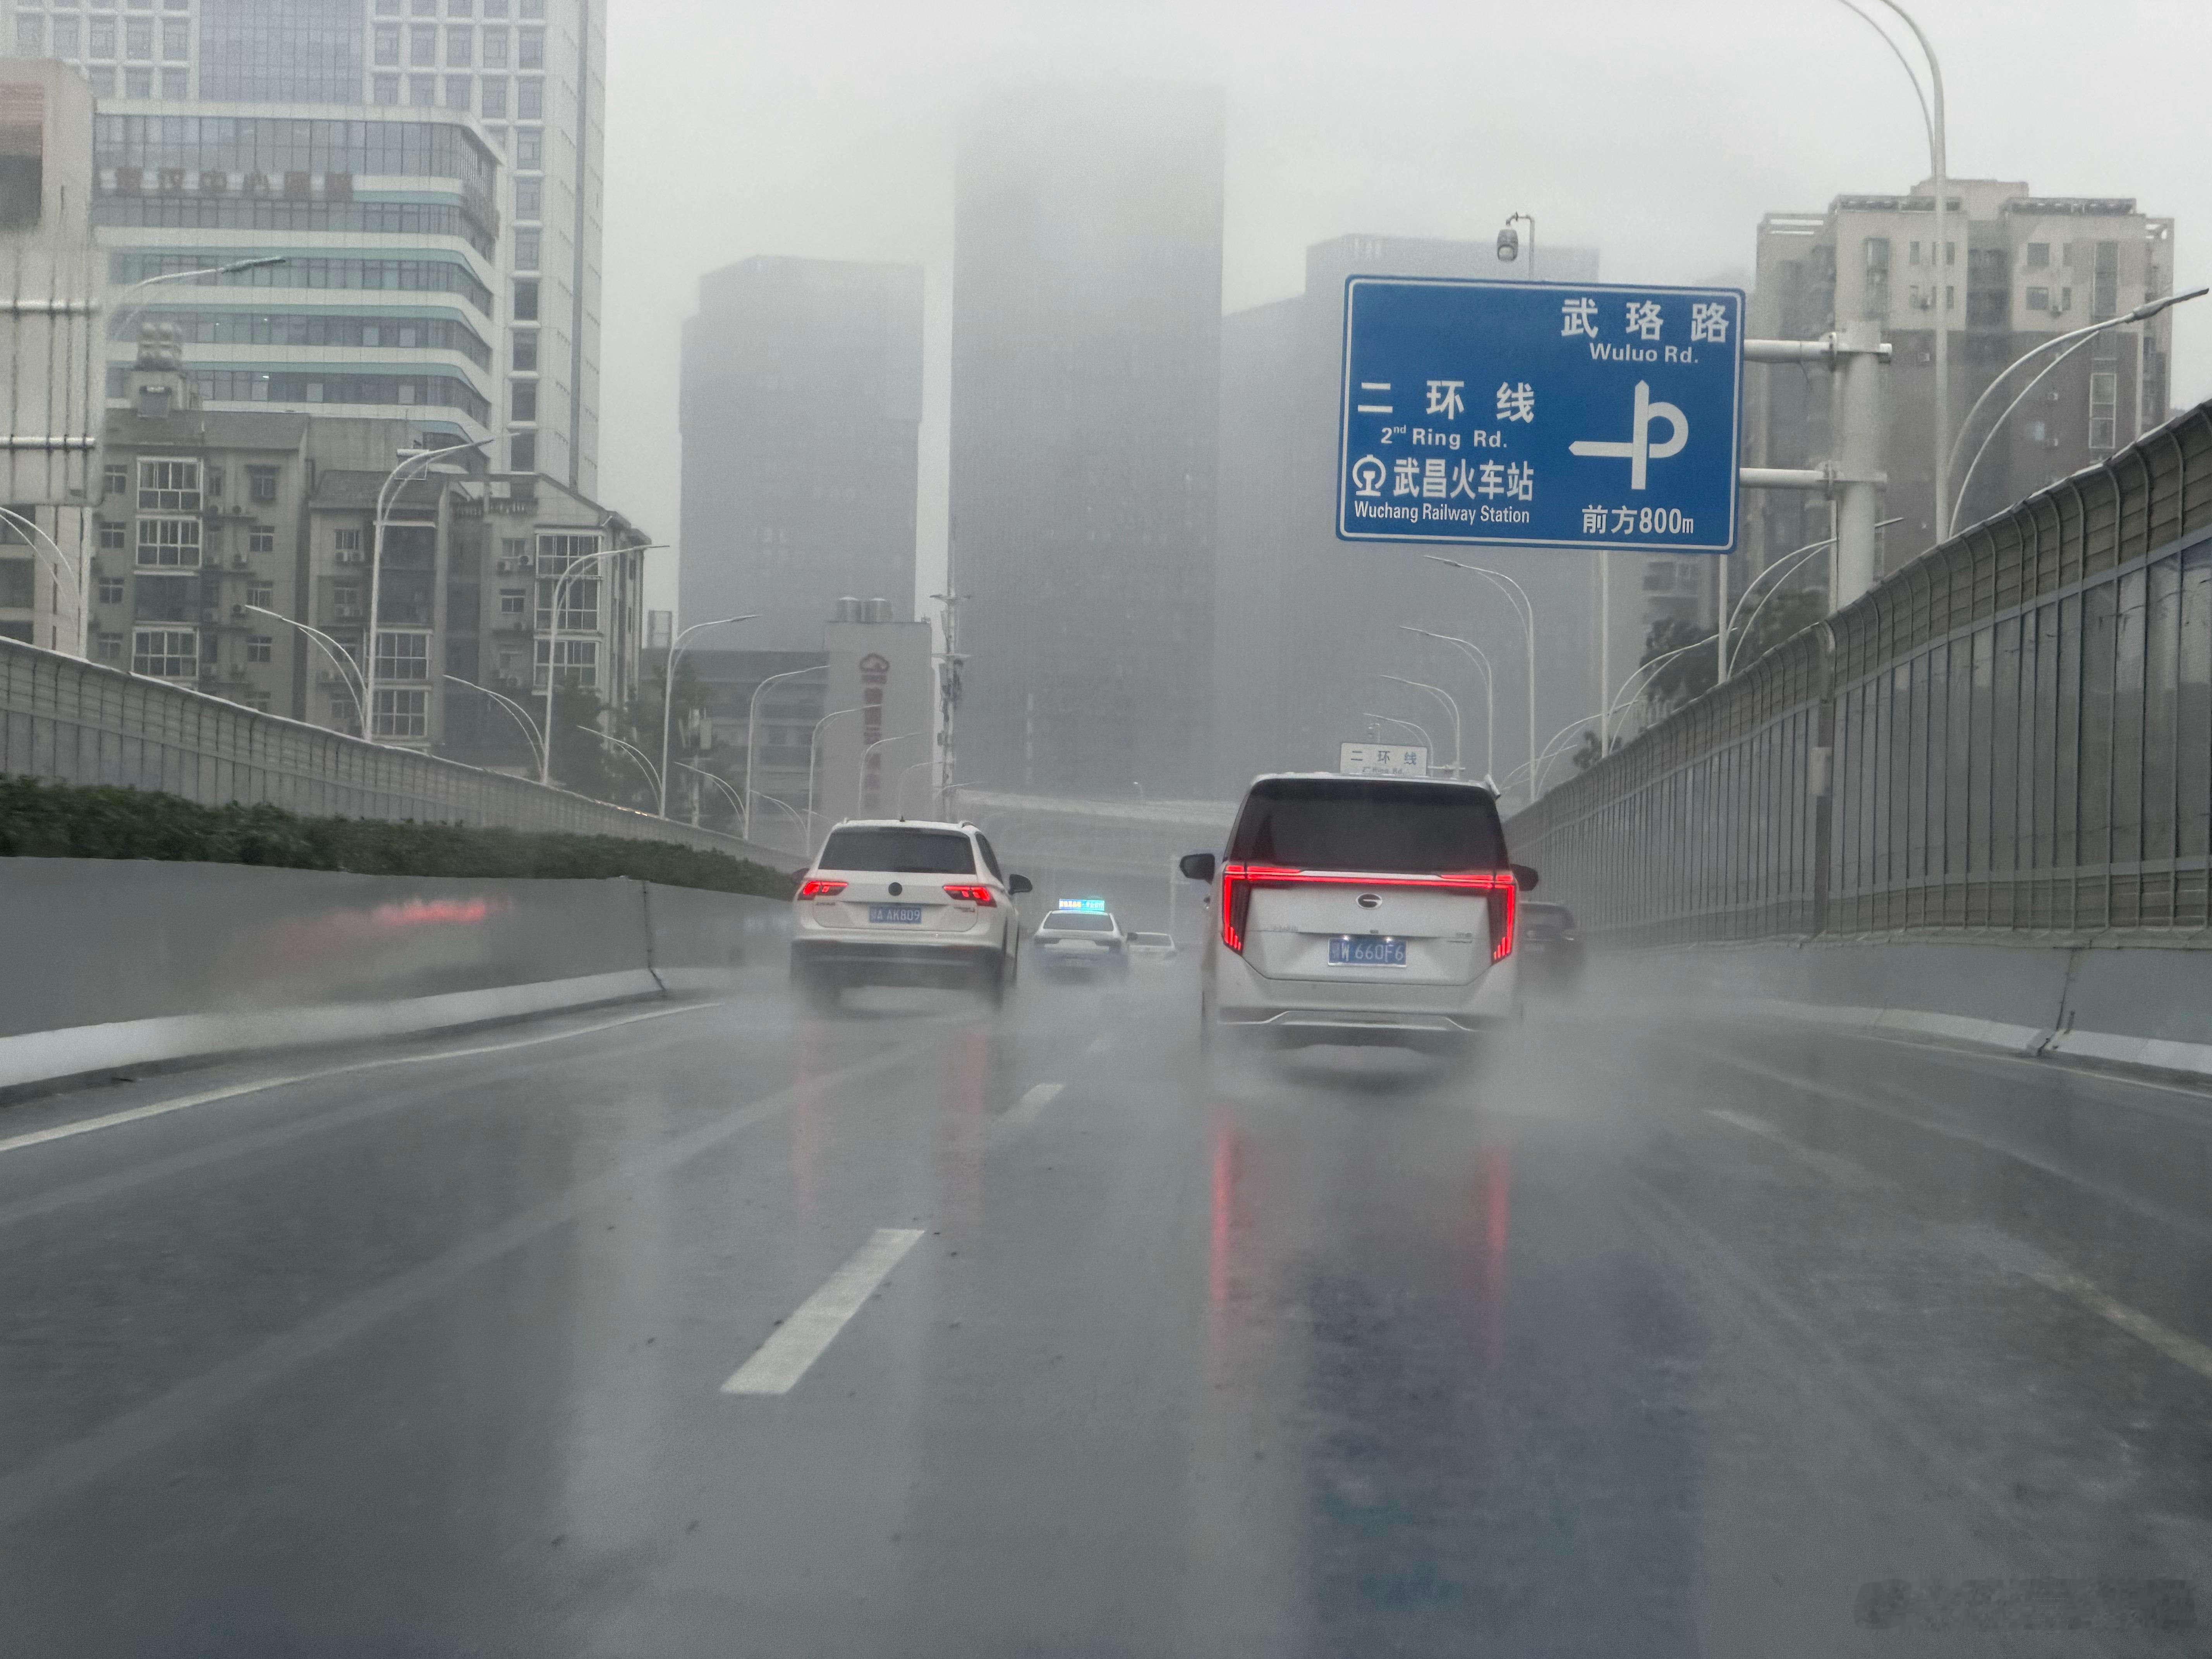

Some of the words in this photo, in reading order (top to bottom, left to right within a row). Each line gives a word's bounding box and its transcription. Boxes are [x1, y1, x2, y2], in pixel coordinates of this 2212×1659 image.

[1561, 297, 1729, 343] 武珞路
[1590, 343, 1657, 362] Wuluo
[1665, 346, 1698, 363] Rd.
[1357, 380, 1535, 423] 二环线
[1413, 428, 1460, 450] Ring
[1474, 430, 1507, 448] Rd.
[1393, 457, 1534, 501] 武昌火车站
[1354, 500, 1418, 523] Wuchang
[1422, 503, 1476, 525] Railway
[1480, 505, 1530, 523] Station
[1582, 505, 1694, 534] 前方800m
[1351, 750, 1417, 765] 二环线
